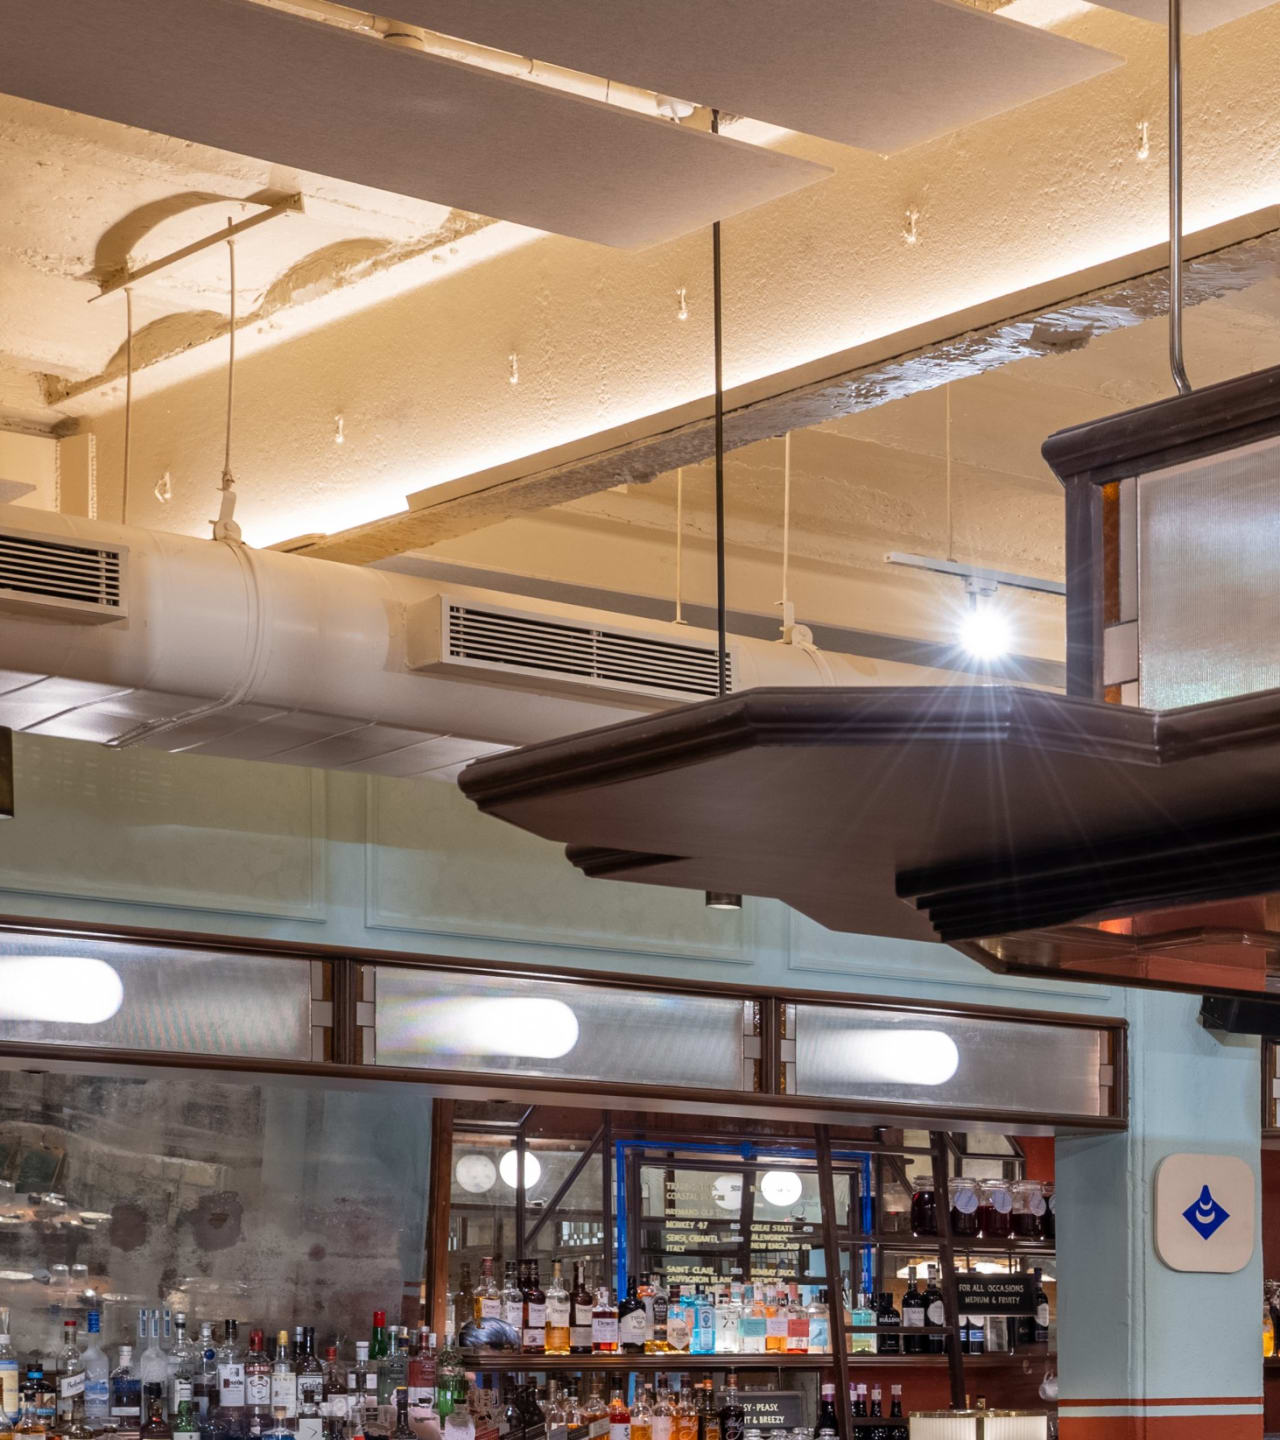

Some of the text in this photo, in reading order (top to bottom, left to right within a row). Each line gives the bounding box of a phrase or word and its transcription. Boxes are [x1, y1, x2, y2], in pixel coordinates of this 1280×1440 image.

[697, 1221, 708, 1230] 47
[959, 1284, 1024, 1292] FOR ALL OCCASIONS
[965, 1296, 1020, 1304] MEDIUM & FRUITY
[752, 1416, 758, 1424] &
[759, 1416, 785, 1424] BREEZY
